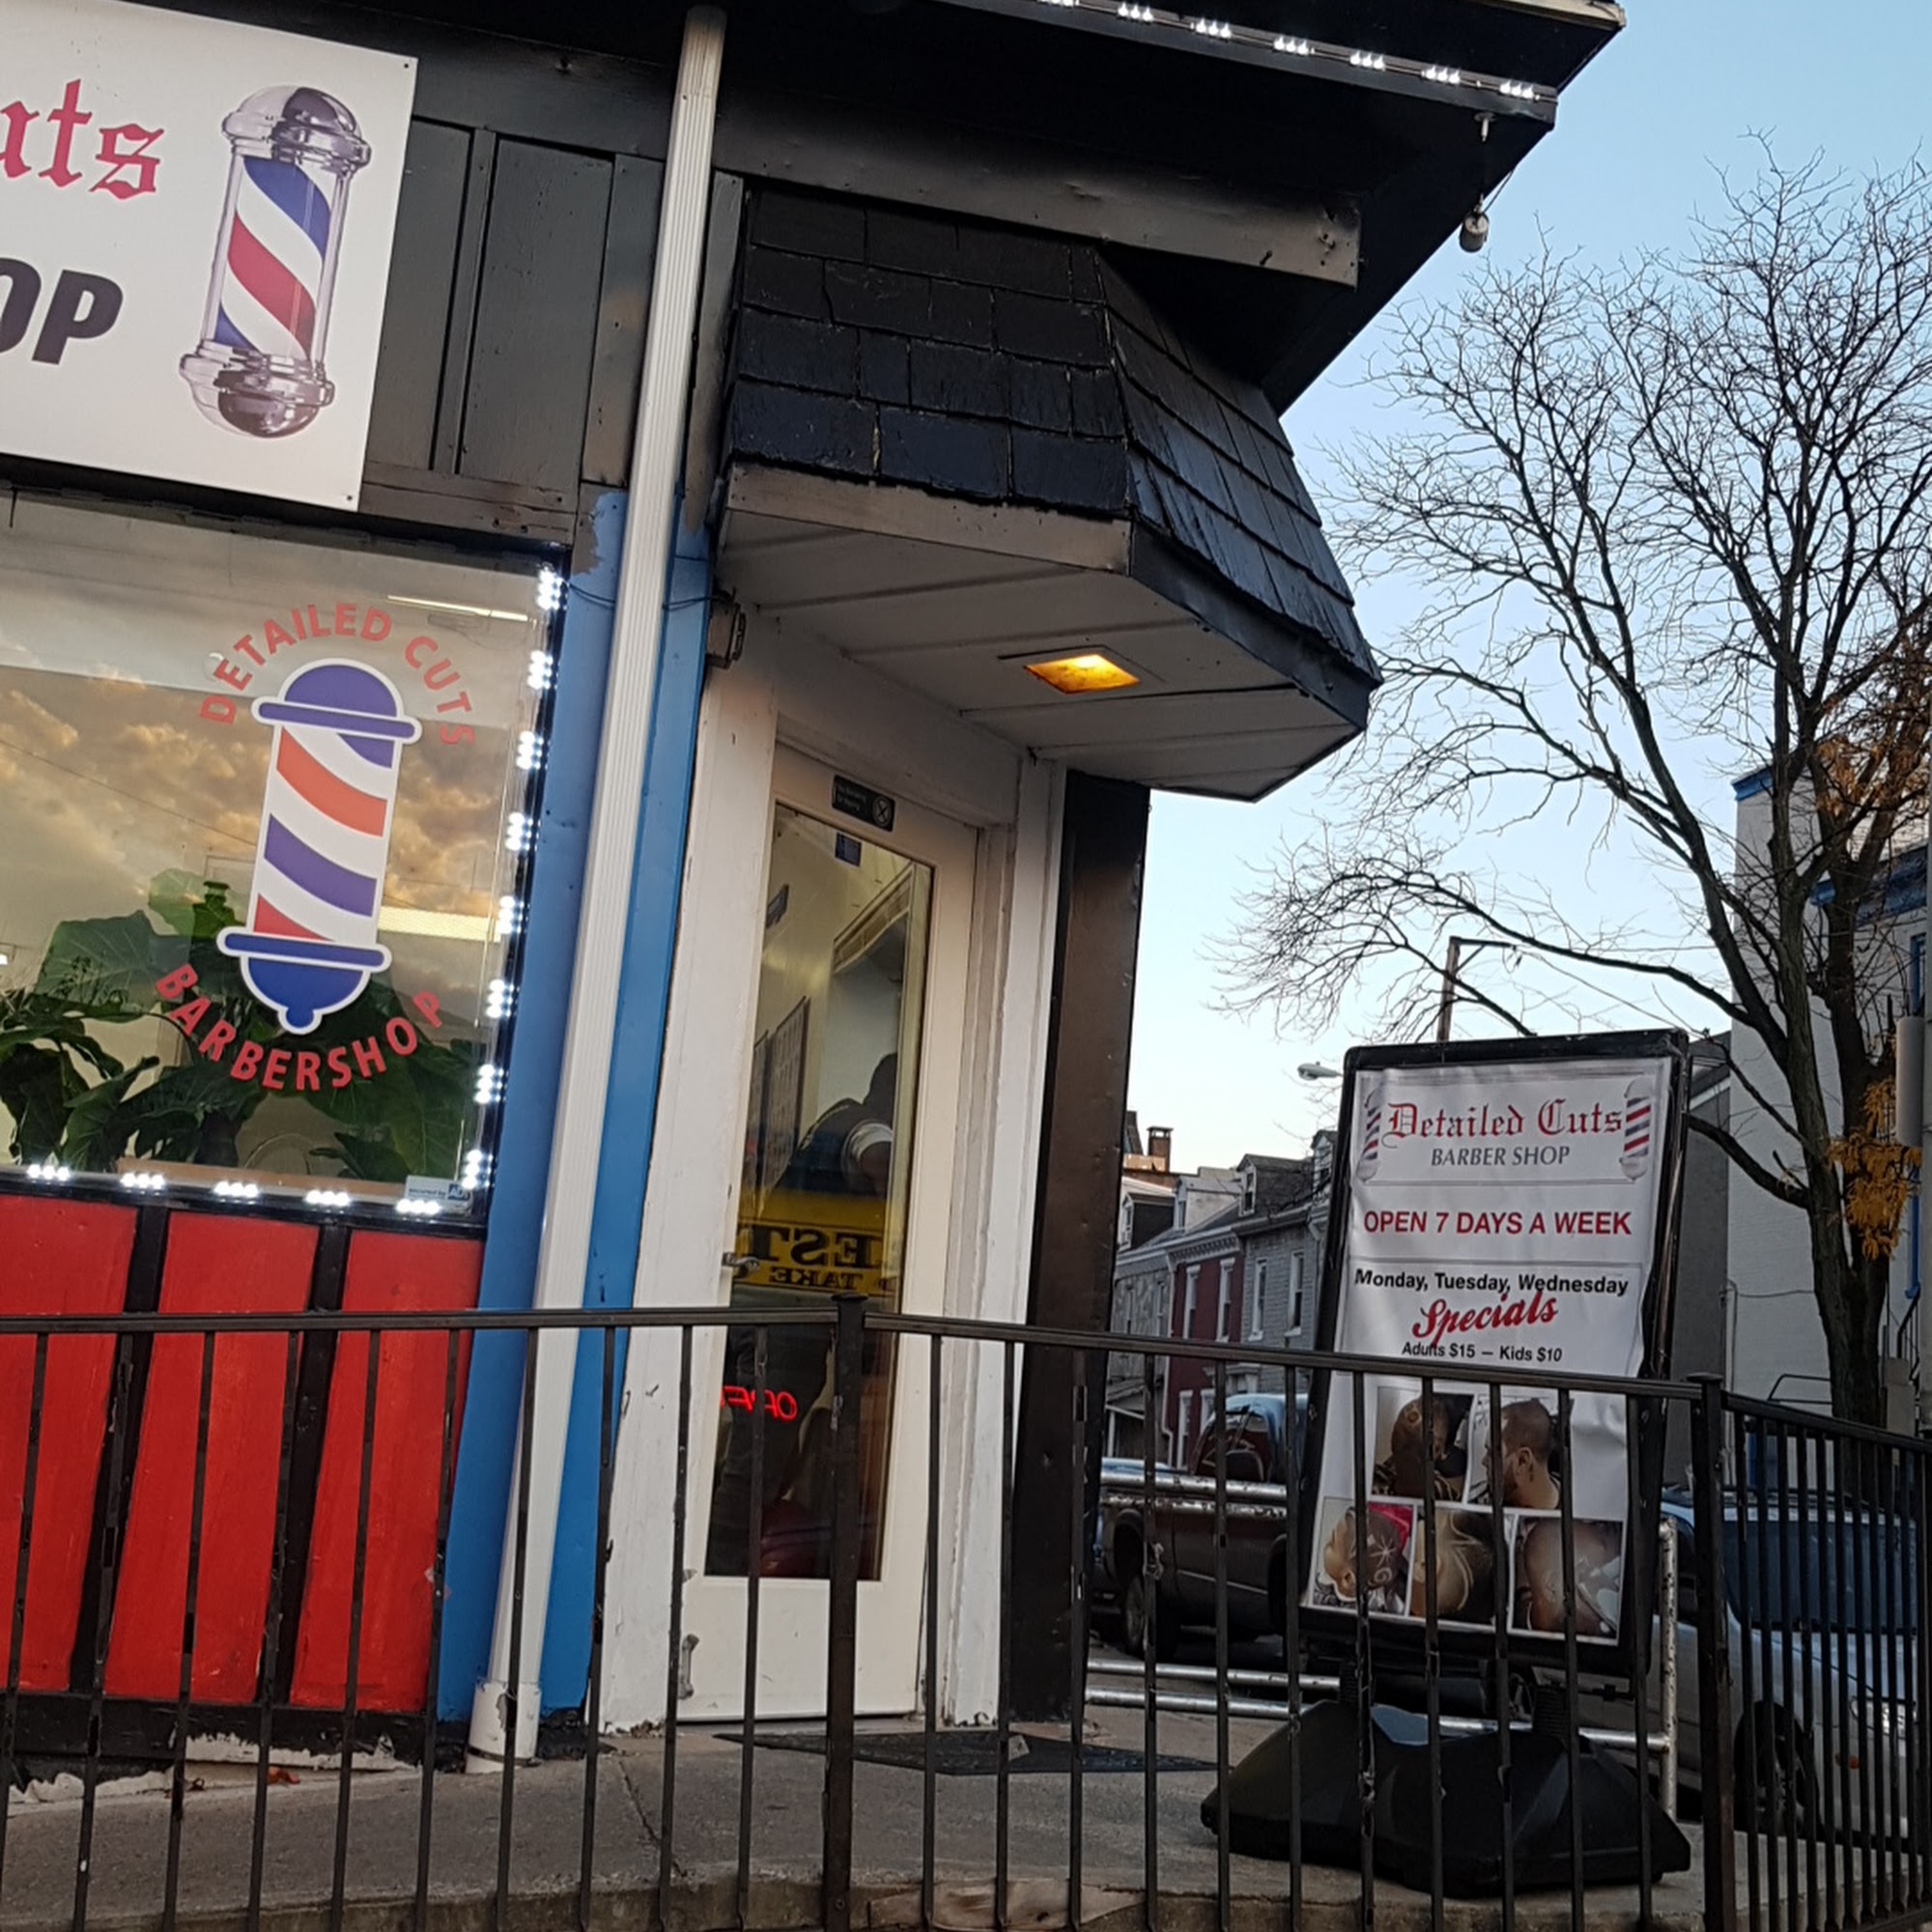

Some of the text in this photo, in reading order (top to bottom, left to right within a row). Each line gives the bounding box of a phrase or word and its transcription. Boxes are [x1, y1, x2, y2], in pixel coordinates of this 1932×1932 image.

[200, 603, 474, 746] DETAILED CUTS
[156, 963, 442, 1092] BARBERSHOP
[1381, 1098, 1623, 1149] Detailed Cuts
[1431, 1146, 1570, 1167] BARBER SHOP
[1363, 1210, 1632, 1235] OPEN 7 DAYS A WEEK
[1354, 1268, 1629, 1297] Monday, Tuesday, Wednesday
[1412, 1290, 1558, 1350] Specials
[1402, 1342, 1445, 1357] Adults
[1449, 1343, 1475, 1358] $15
[1499, 1345, 1532, 1361] Kids
[1537, 1347, 1563, 1362] $10
